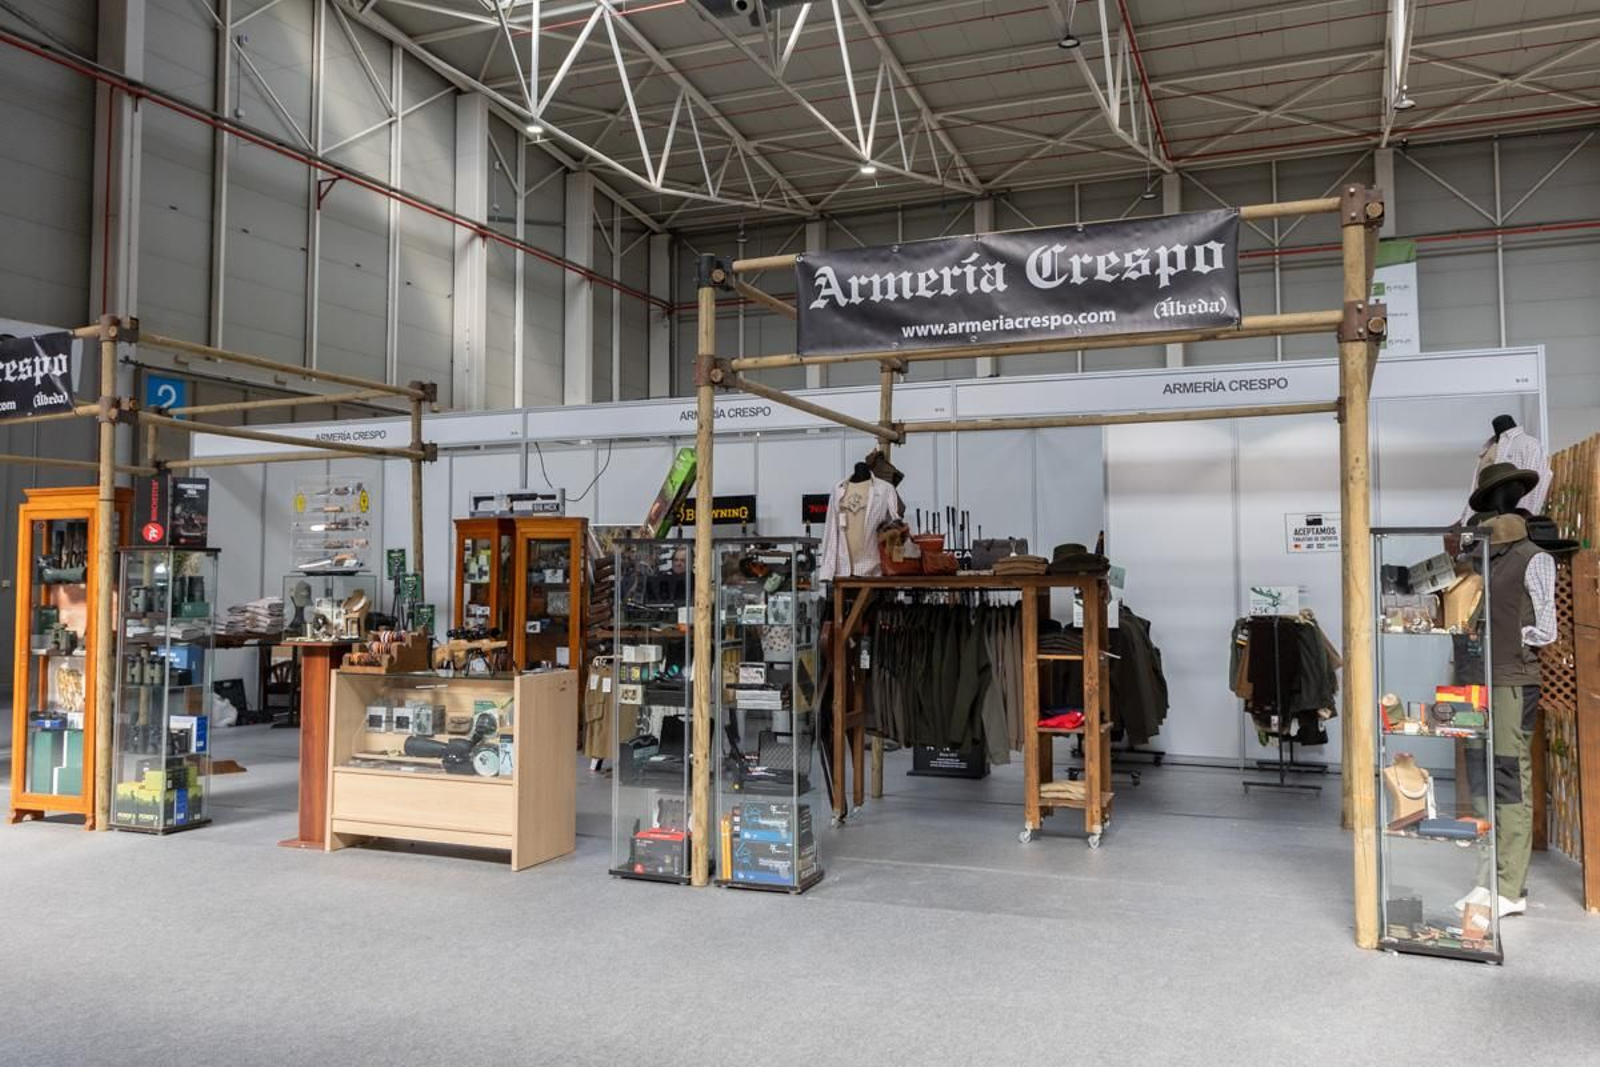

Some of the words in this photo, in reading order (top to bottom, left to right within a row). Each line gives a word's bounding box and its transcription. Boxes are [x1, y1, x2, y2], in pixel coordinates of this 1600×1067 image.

[809, 253, 1008, 310] Armería
[1026, 239, 1226, 289] Crespo
[1154, 296, 1228, 320] (Úbeda)
[902, 308, 1116, 338] www.armeriacrespo.com
[1163, 379, 1227, 396] ARMERÍA
[1228, 377, 1288, 392] CRESPO
[727, 406, 772, 419] CRESPO
[315, 430, 351, 442] ARMERÍA
[352, 429, 387, 441] CRESPO
[686, 507, 748, 521] BWNING
[1294, 527, 1337, 535] ACEPTAMOS
